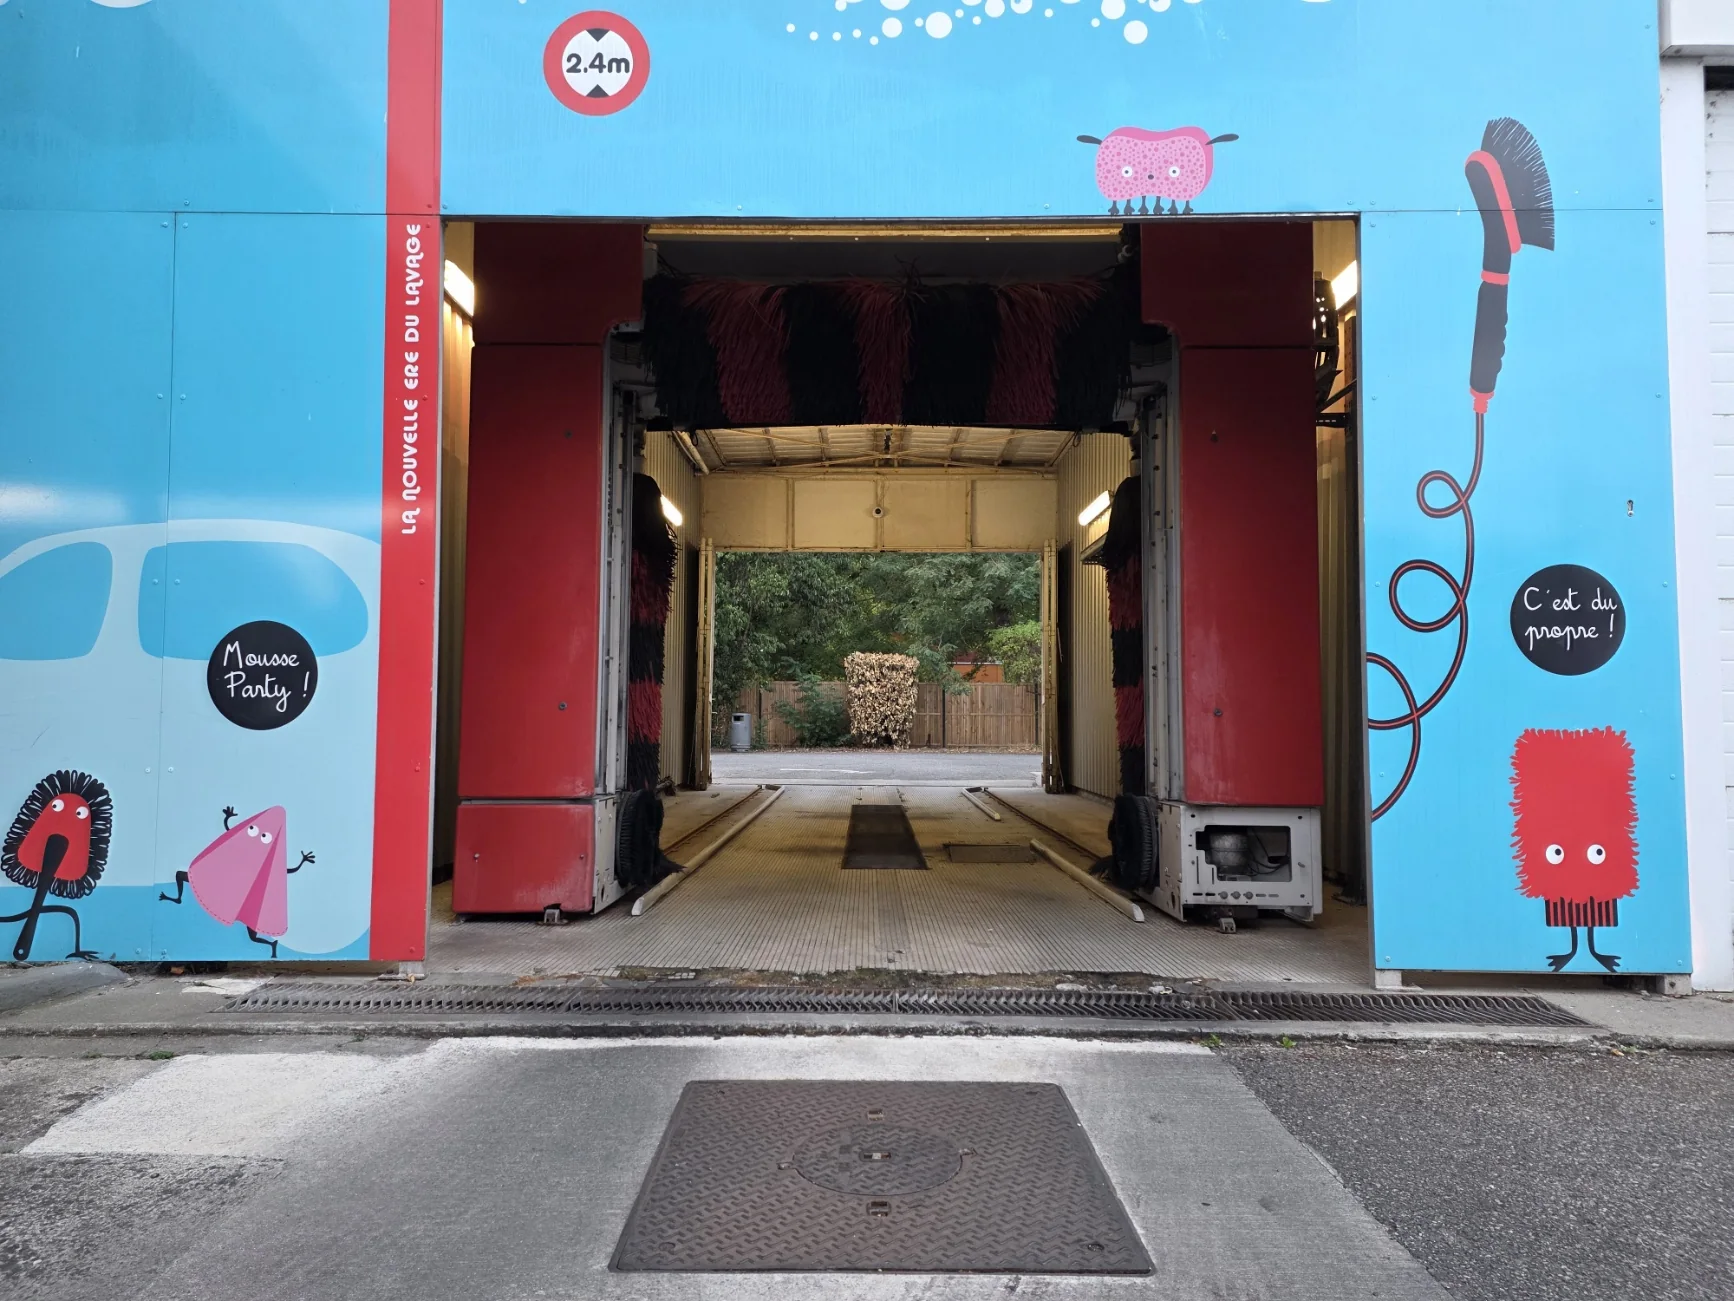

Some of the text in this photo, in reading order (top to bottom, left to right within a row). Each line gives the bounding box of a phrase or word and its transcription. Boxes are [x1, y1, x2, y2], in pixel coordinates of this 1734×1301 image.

[566, 52, 630, 74] 2.4m
[401, 223, 425, 535] LA NOUVELLE ERE DU LAVAGE
[1523, 586, 1618, 611] C'est du
[1524, 625, 1600, 651] propre
[223, 640, 300, 669] Mousse
[224, 670, 292, 713] Party
